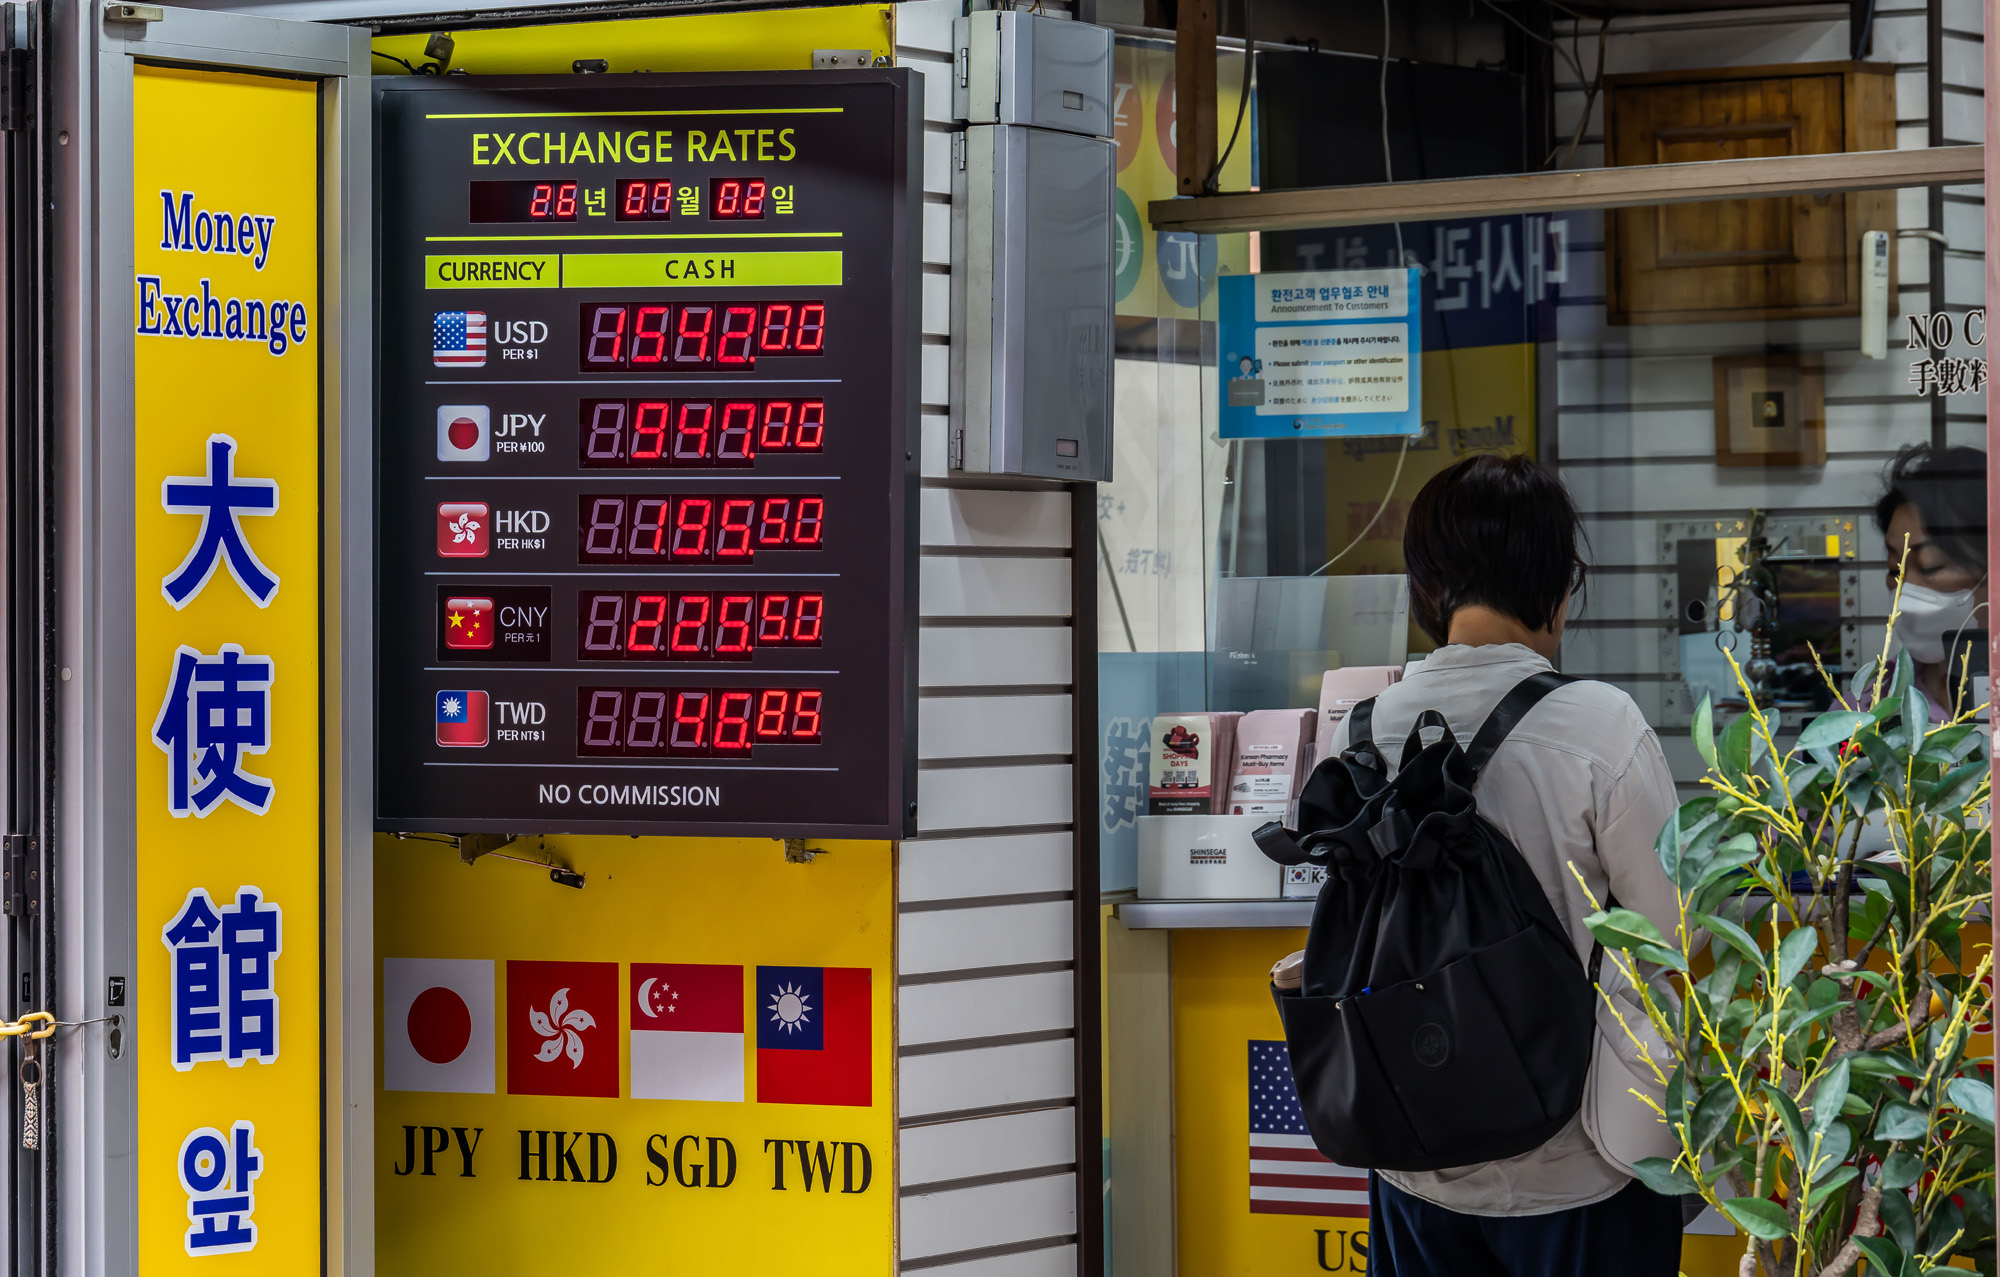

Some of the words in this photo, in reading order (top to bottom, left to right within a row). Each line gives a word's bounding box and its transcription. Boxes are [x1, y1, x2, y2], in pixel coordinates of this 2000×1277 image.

[473, 130, 673, 165] EXCHANGE
[688, 128, 797, 162] RATES
[530, 184, 578, 216] 26
[585, 187, 606, 216] 년
[625, 183, 672, 215] 07
[676, 186, 700, 216] 월
[717, 182, 766, 215] 02
[772, 185, 794, 215] 일
[160, 190, 276, 270] Money
[438, 261, 546, 282] CURRENCY
[665, 259, 735, 279] CASH
[1271, 287, 1315, 302] 환전고객
[1319, 286, 1363, 301] 업무협조
[1367, 285, 1389, 298] 안내
[137, 276, 306, 355] Exchange
[1271, 303, 1332, 313] Announcement
[1334, 303, 1344, 311] To
[1346, 302, 1389, 311] Customers
[494, 320, 548, 344] USD
[1907, 313, 1953, 349] NO
[1963, 310, 1986, 346] C
[502, 348, 524, 360] PER
[526, 348, 538, 360] $1
[495, 414, 546, 437] JPY
[496, 442, 518, 453] PER
[520, 442, 545, 453] ¥100
[496, 510, 550, 533] HKD
[497, 538, 519, 550] PER
[521, 538, 545, 550] HK$1
[500, 606, 548, 627] CNY
[504, 632, 525, 643] PER
[495, 702, 546, 725] TWD
[497, 730, 519, 741] PER
[521, 730, 545, 742] NT$1
[539, 784, 570, 804] NO
[578, 785, 720, 806] COMMISSION
[1190, 848, 1227, 856] SHINSEGAE
[1311, 870, 1325, 884] K-
[394, 1125, 484, 1178] JPY
[518, 1130, 618, 1184] HKD
[646, 1134, 737, 1188] SGD
[764, 1139, 873, 1194] TWD
[1313, 1229, 1369, 1273] US
